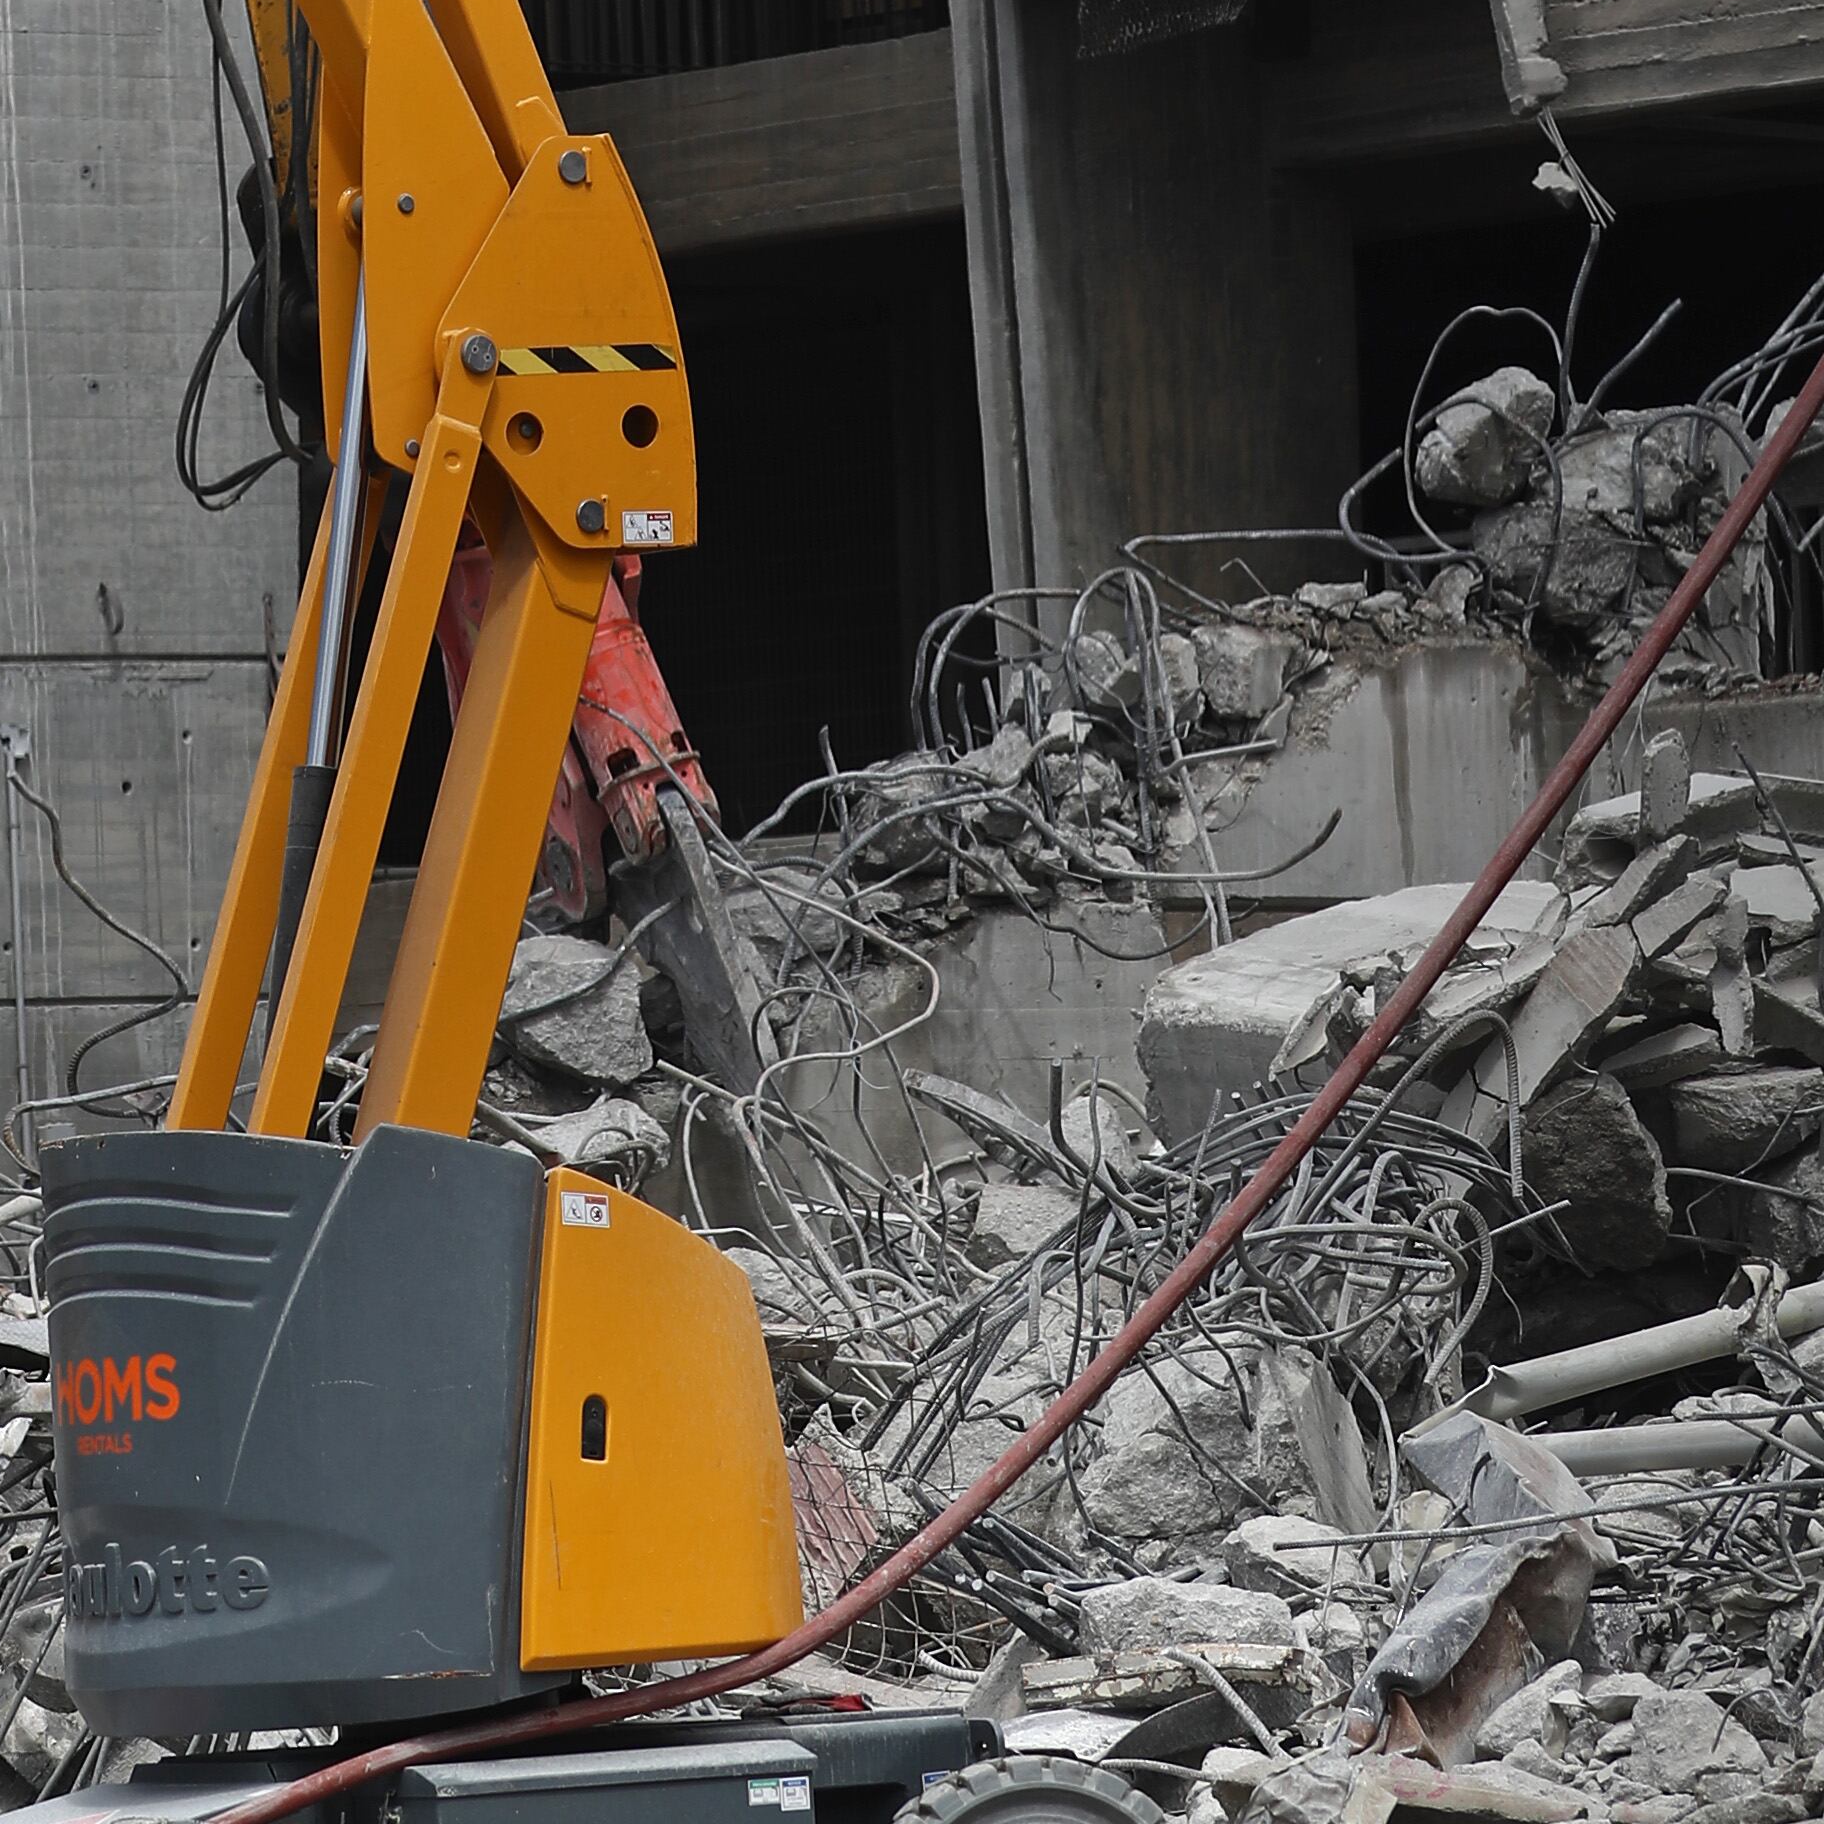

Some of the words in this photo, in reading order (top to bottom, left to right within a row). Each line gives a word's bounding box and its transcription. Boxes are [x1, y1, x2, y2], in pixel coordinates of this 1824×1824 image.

[56, 1352, 181, 1426] HOMS
[77, 1431, 133, 1457] RENTALS
[66, 1542, 270, 1618] aulotte
